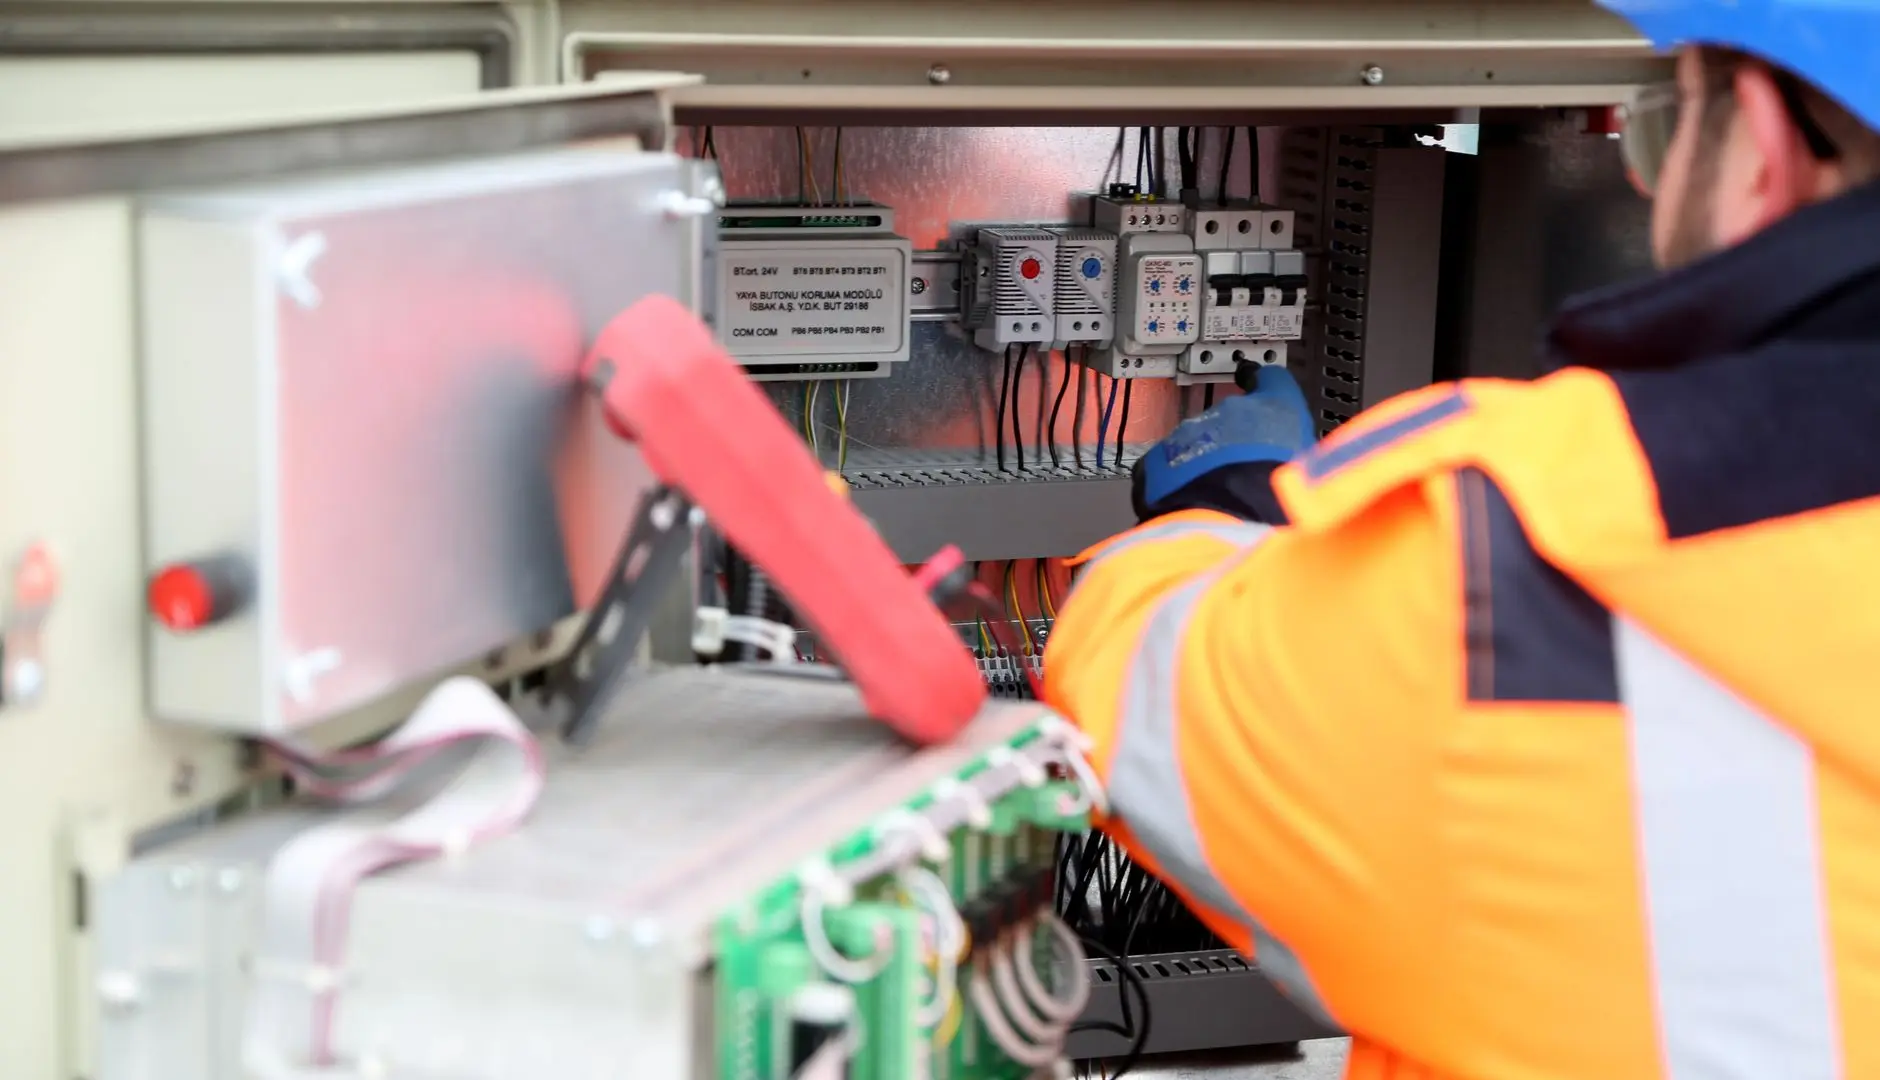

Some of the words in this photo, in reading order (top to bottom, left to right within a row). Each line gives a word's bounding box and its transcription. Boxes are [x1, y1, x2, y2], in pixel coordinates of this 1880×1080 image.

[761, 266, 779, 276] 24V
[825, 266, 840, 275] BT4
[842, 266, 855, 275] BT3
[857, 266, 871, 275] BT2
[873, 266, 886, 275] BT1
[736, 291, 757, 300] YAYA
[760, 291, 799, 300] BUTONU
[801, 290, 841, 299] KORUMA
[843, 288, 883, 299] MODÜLÜ
[749, 301, 776, 311] İSBAK
[778, 302, 795, 312] A.Ş.
[823, 302, 842, 310] BUT
[733, 328, 755, 337] COM
[756, 328, 778, 337] COM
[792, 326, 806, 335] PB6
[824, 326, 838, 335] PB4
[840, 326, 854, 335] PB3
[856, 326, 870, 335] PB2
[872, 326, 885, 335] PB1
